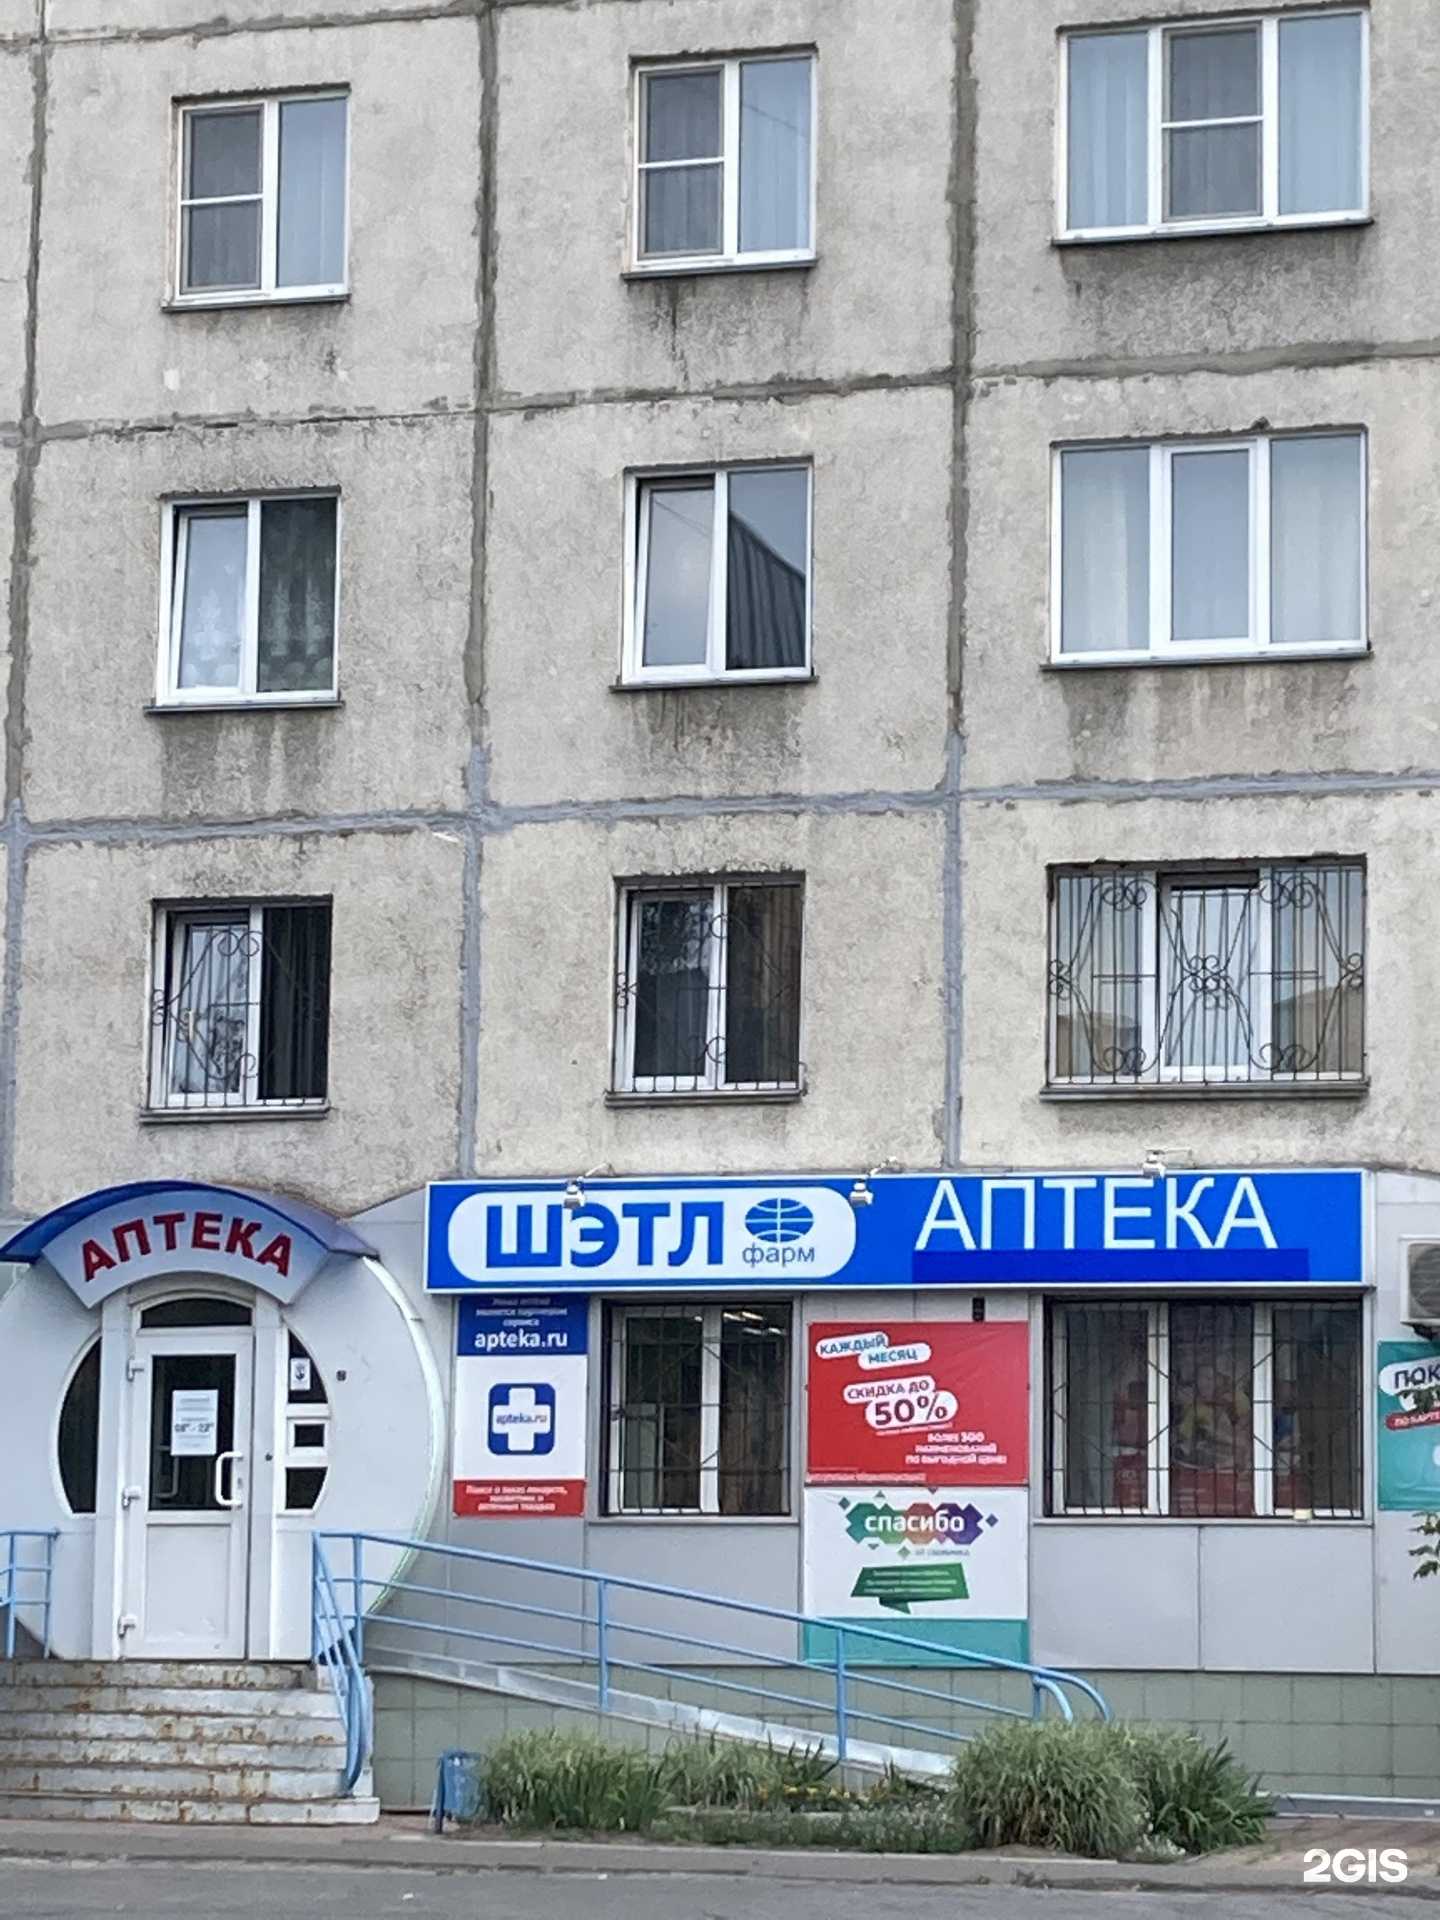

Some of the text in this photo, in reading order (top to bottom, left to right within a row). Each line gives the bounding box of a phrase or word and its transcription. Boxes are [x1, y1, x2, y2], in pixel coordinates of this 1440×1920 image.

[914, 1176, 1279, 1251] АПТЕКА
[486, 1201, 725, 1268] ШЭТЛ
[82, 1211, 293, 1283] АПТЕКА
[742, 1242, 816, 1268] фарм
[474, 1328, 568, 1352] apteka.ru
[819, 1333, 887, 1355] КАЖДЫЙ
[868, 1349, 919, 1365] МЕСЯЦ
[847, 1379, 930, 1400] СКИДКА ДО
[495, 1412, 548, 1426] apteka.ru
[874, 1394, 948, 1426] 50%
[864, 1509, 965, 1532] спасибо
